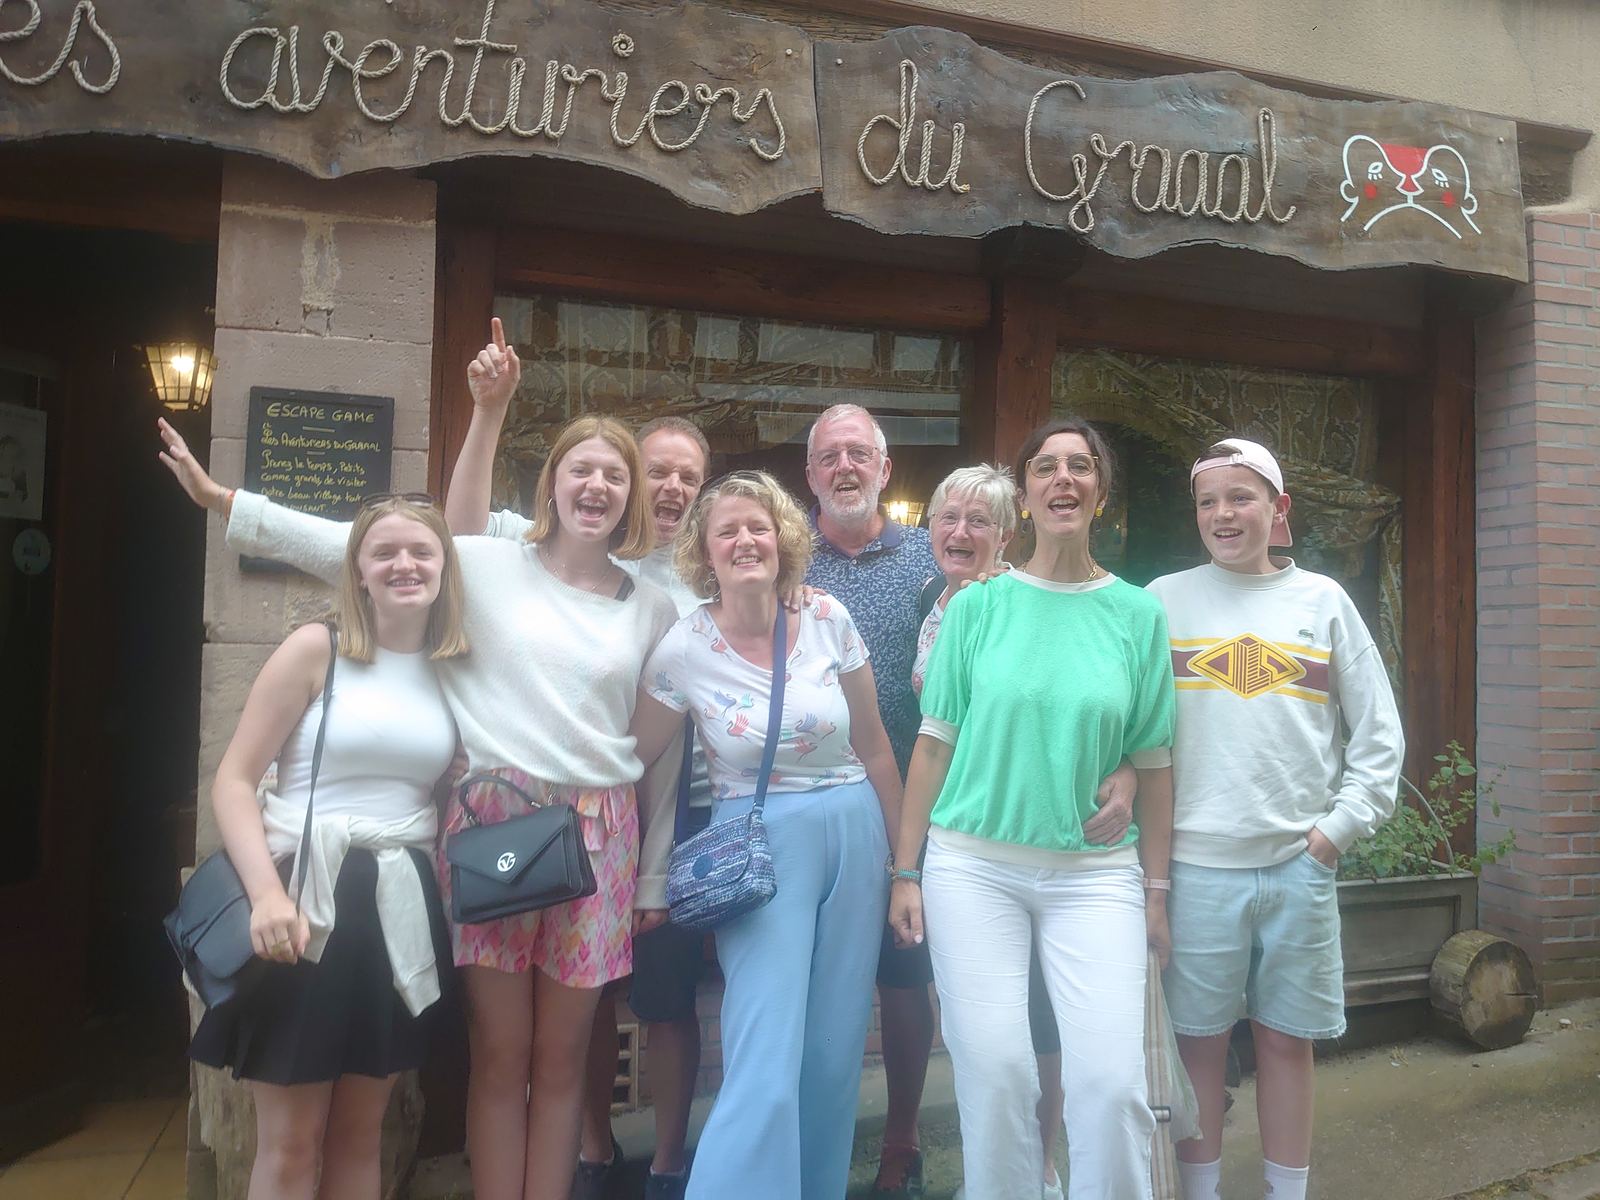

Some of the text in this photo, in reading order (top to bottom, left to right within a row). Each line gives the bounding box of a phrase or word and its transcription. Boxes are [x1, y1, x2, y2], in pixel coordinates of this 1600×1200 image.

[856, 59, 972, 194] du
[1023, 79, 1297, 234] Graaal
[266, 402, 375, 423] ESCAPE GAME
